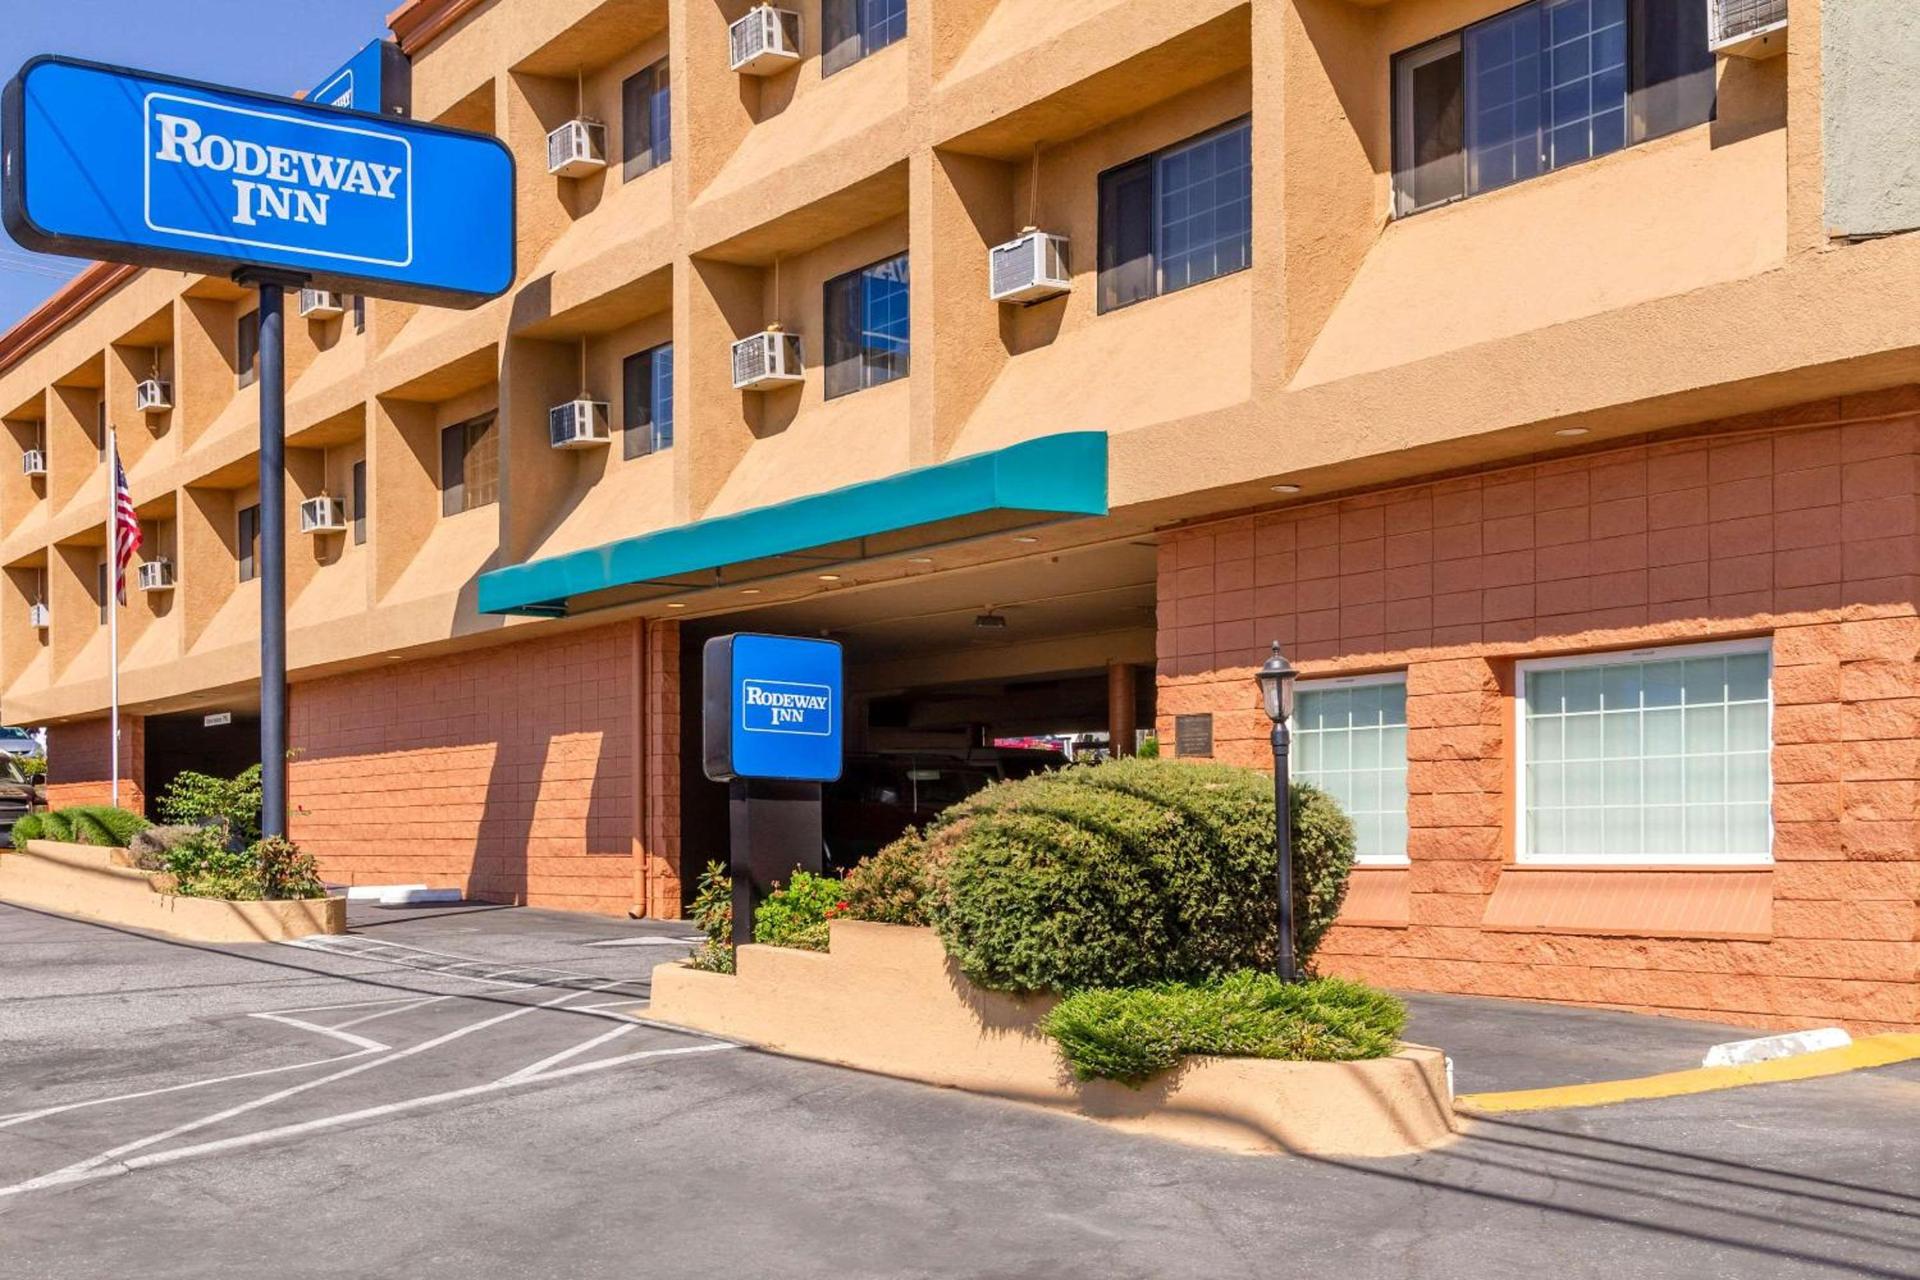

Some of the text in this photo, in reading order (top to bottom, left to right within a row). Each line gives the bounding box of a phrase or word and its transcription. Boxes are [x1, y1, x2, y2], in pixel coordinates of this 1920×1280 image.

[155, 113, 402, 199] RODEWAY
[232, 179, 330, 226] INN
[746, 686, 828, 710] RODEWAY
[771, 707, 805, 725] INN
